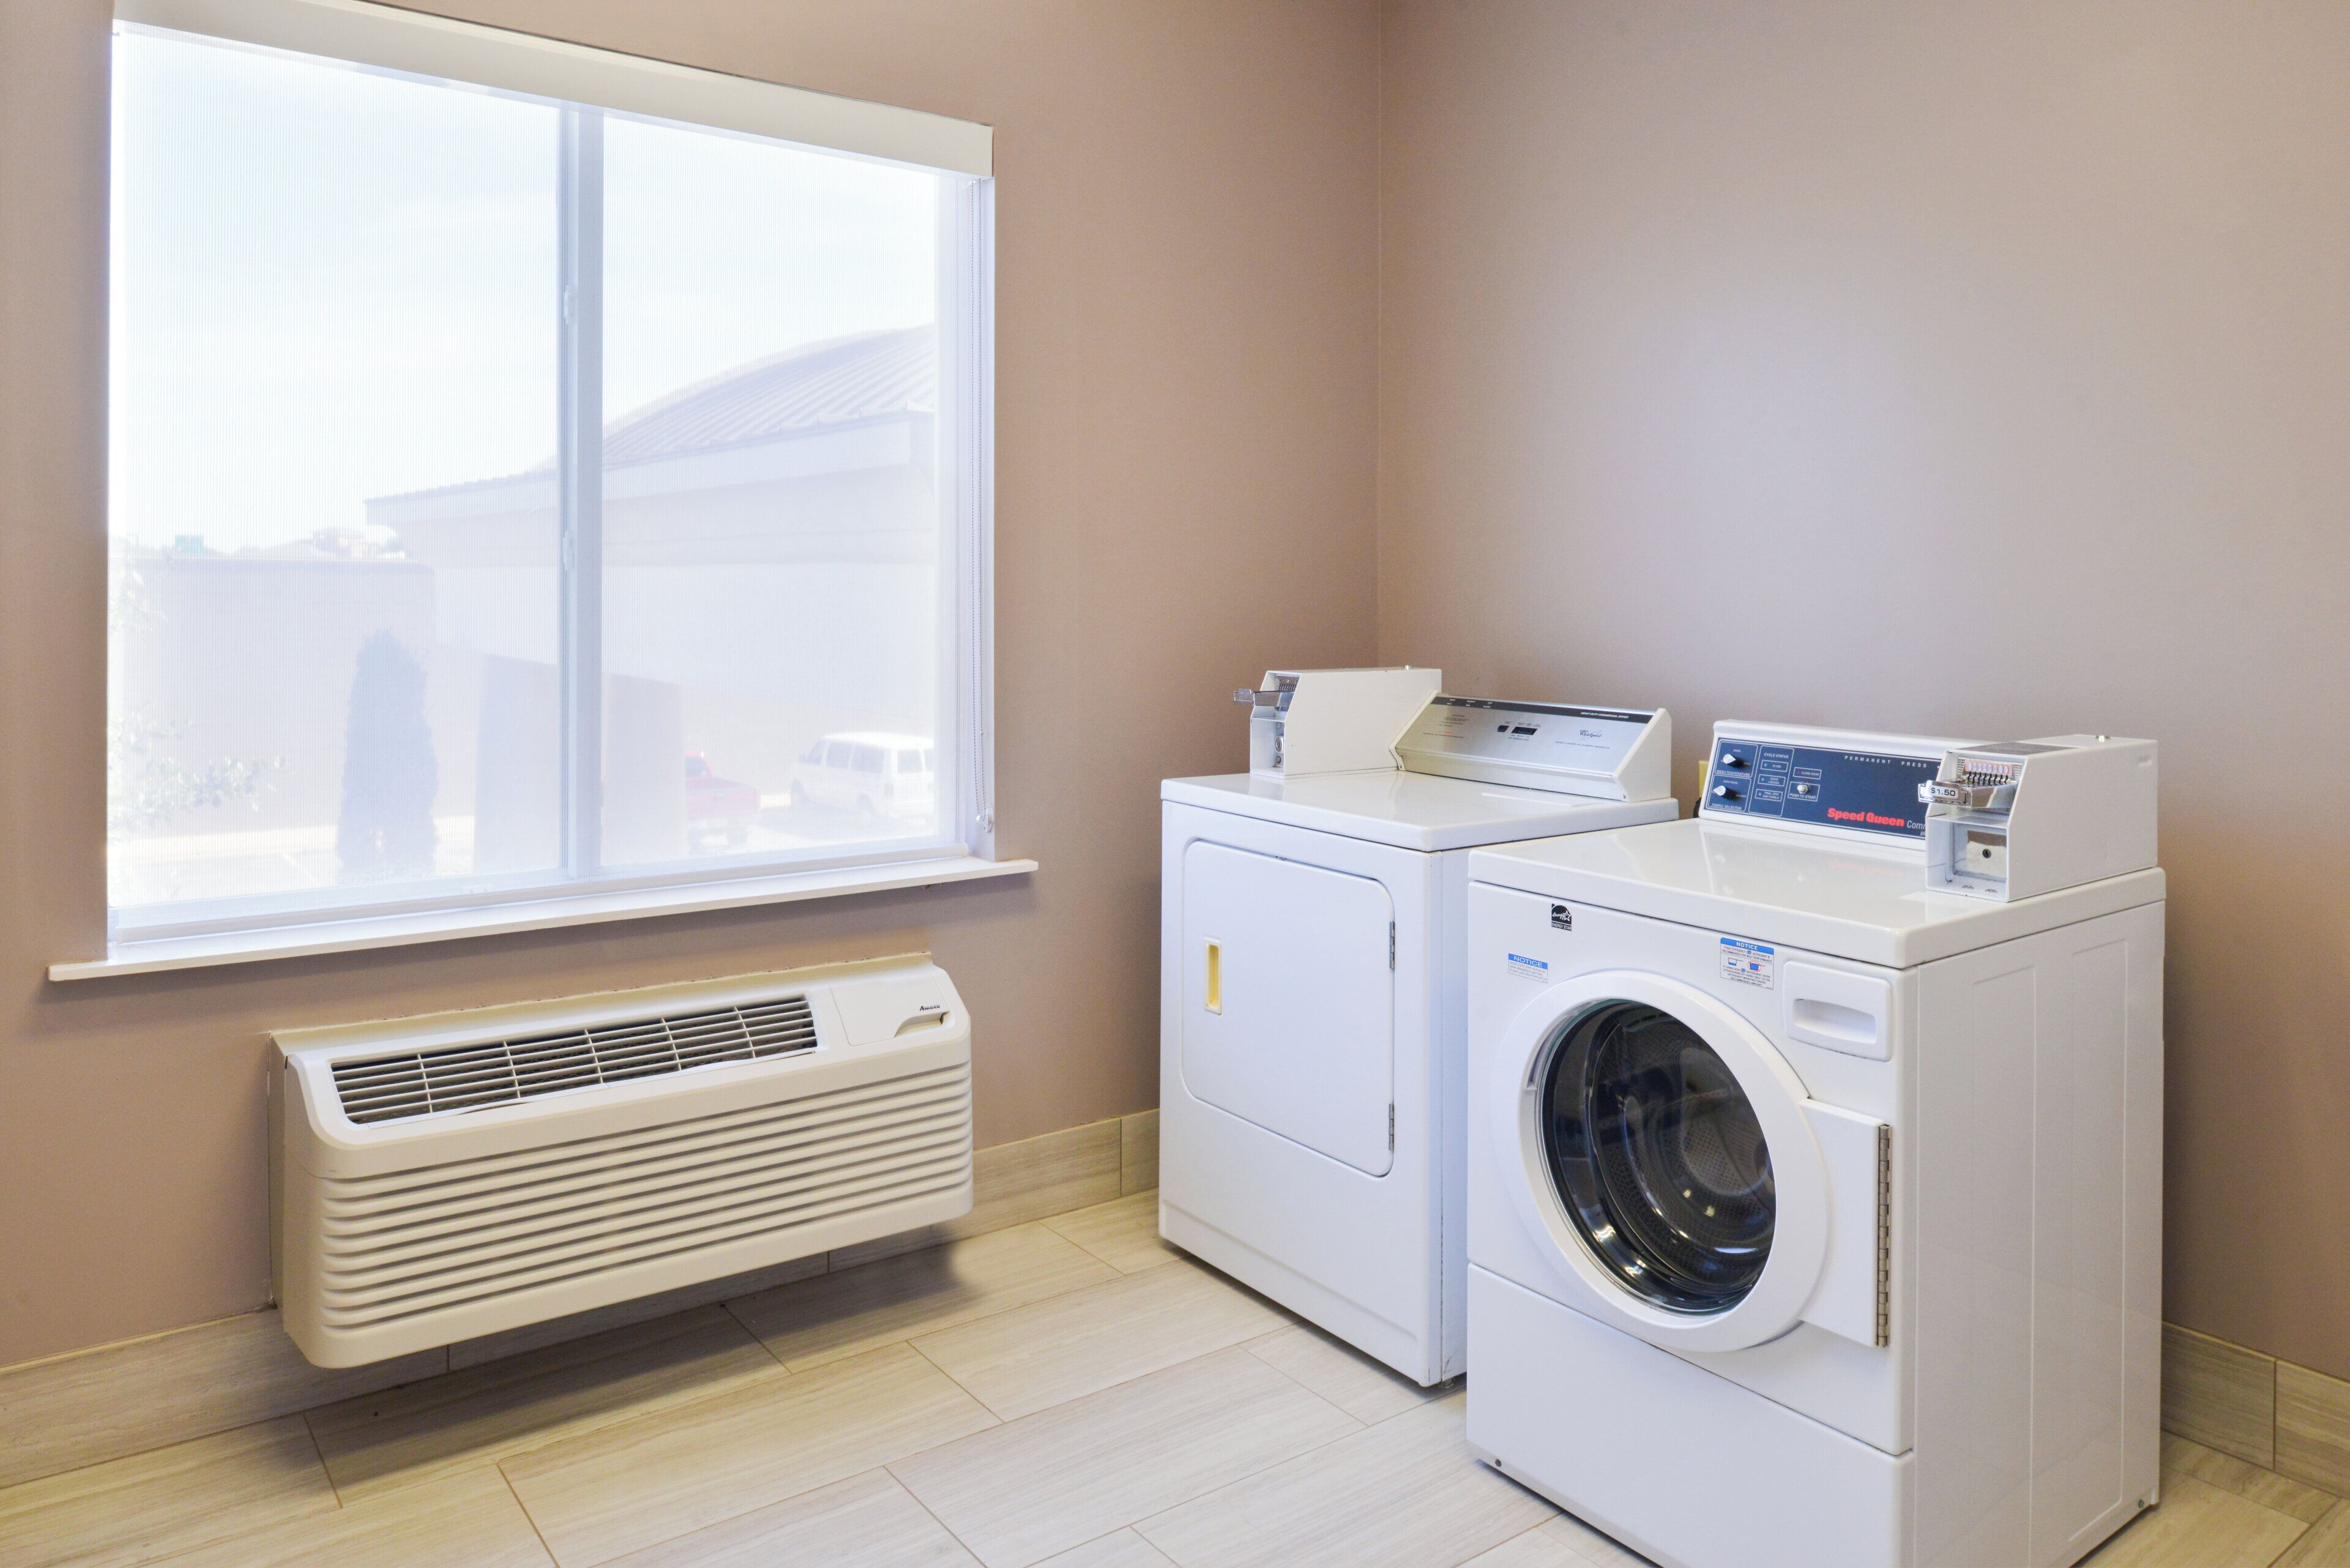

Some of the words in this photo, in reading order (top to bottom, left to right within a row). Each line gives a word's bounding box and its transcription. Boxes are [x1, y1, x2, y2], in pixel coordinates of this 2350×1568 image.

[1845, 755, 1891, 764] PERMANENT
[1931, 787, 1956, 796] $1.50
[1827, 807, 1865, 821] Speed
[1866, 812, 1904, 827] Queen
[1736, 942, 1758, 950] NOTICE
[1513, 955, 1543, 968] NOTICE
